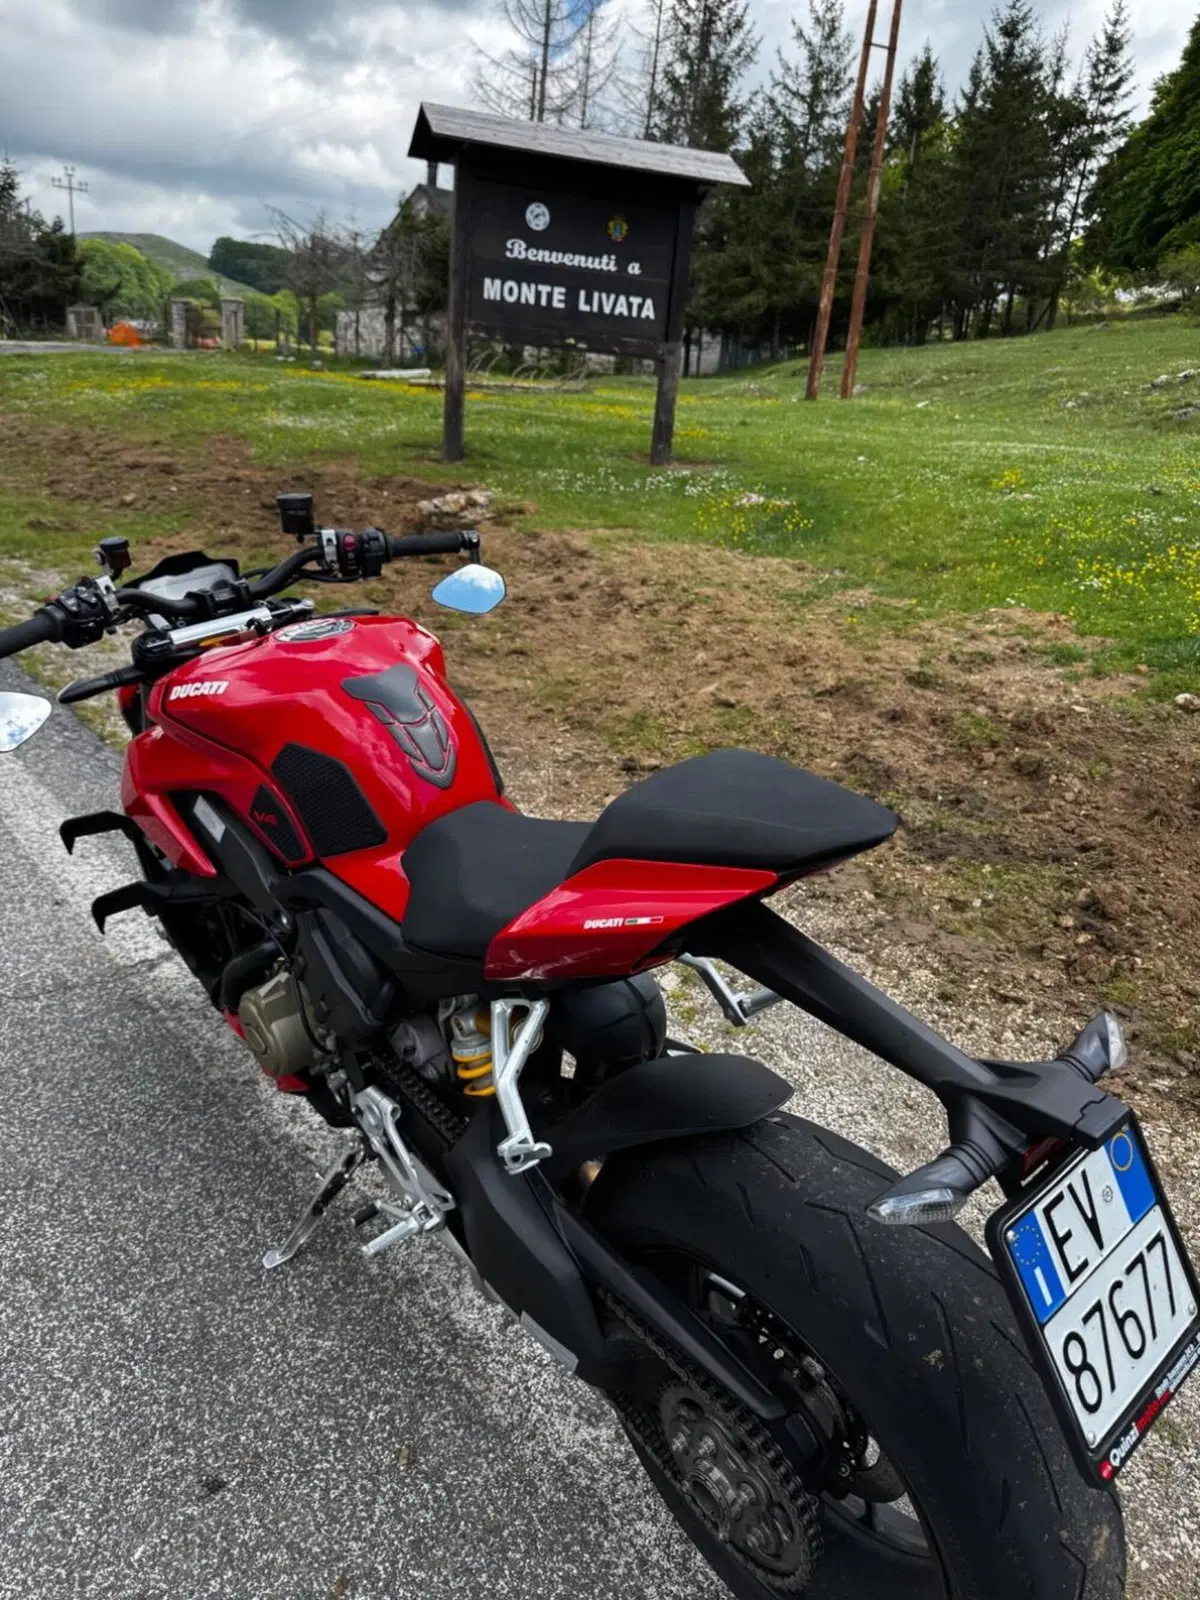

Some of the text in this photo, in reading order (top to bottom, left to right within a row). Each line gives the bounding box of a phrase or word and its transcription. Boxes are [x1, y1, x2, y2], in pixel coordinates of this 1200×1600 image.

[505, 238, 642, 275] Benvenuti a
[483, 277, 655, 320] MONTE LIVATA
[169, 680, 230, 701] DUCATI
[583, 917, 624, 930] DUCATI
[1042, 1168, 1105, 1284] EV
[1033, 1266, 1053, 1306] I
[1062, 1229, 1177, 1415] 87677
